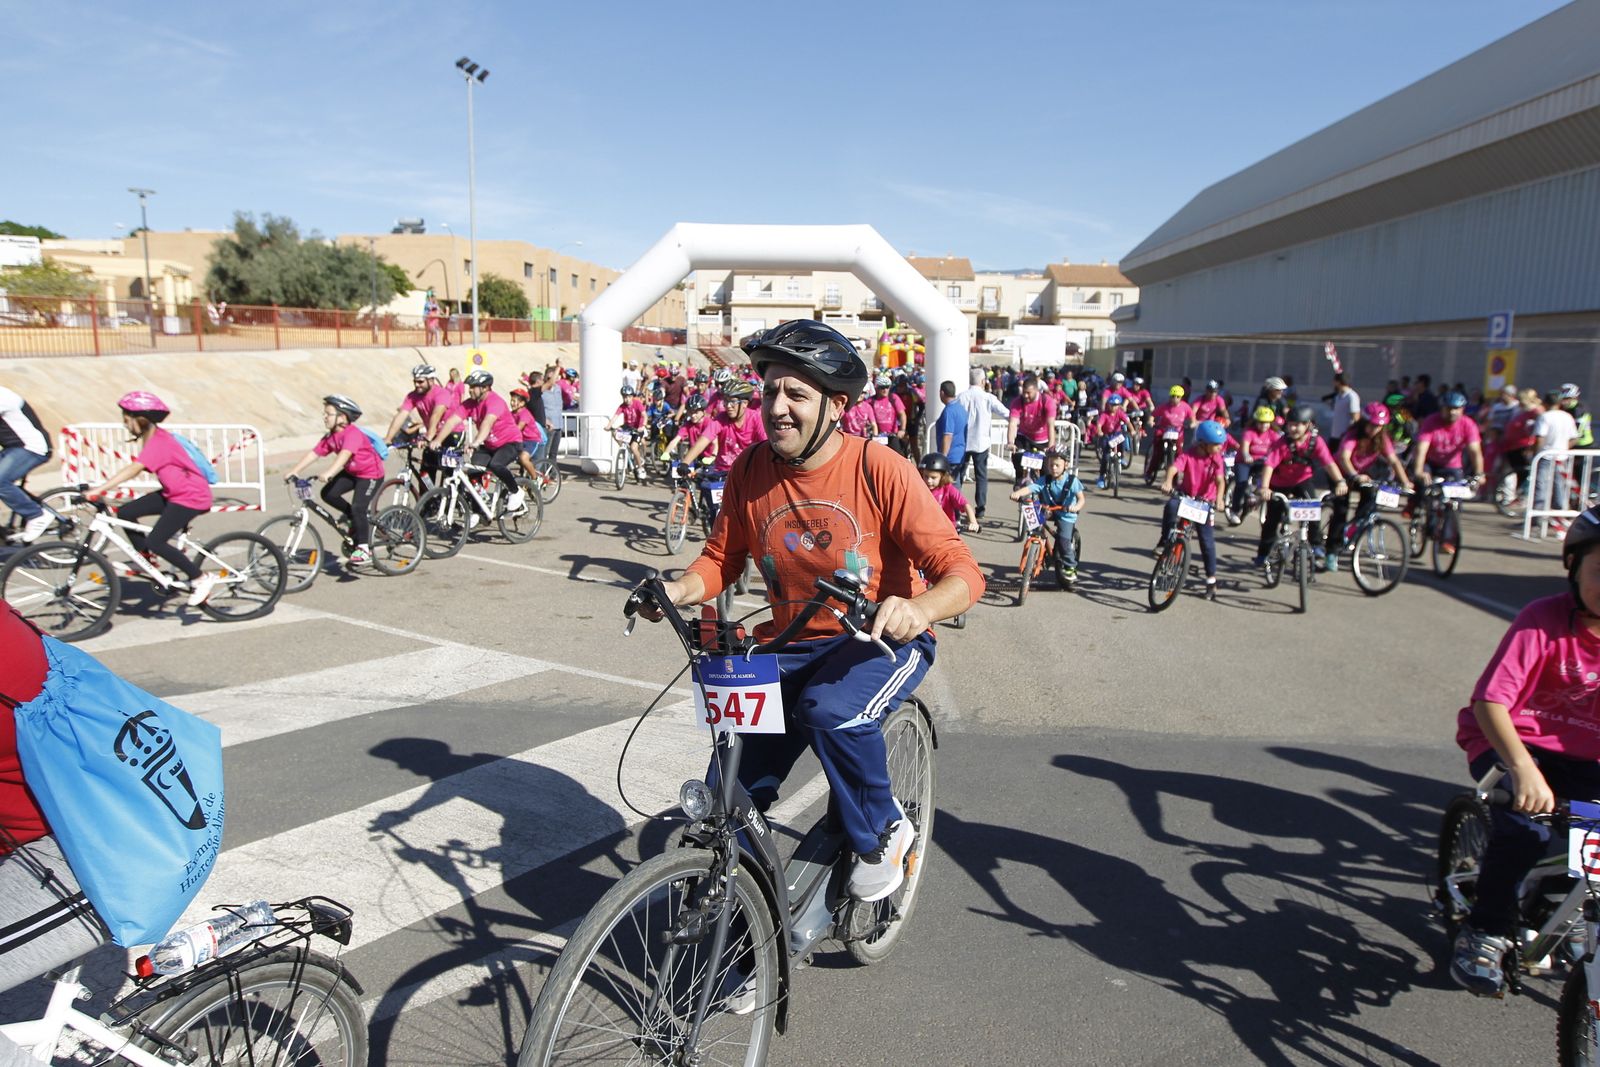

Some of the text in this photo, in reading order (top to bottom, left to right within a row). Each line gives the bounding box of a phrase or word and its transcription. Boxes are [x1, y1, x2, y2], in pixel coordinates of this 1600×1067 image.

[1490, 315, 1507, 343] P
[1024, 506, 1037, 527] 652
[1293, 510, 1317, 520] 655
[705, 691, 767, 727] 547
[202, 791, 217, 808] de
